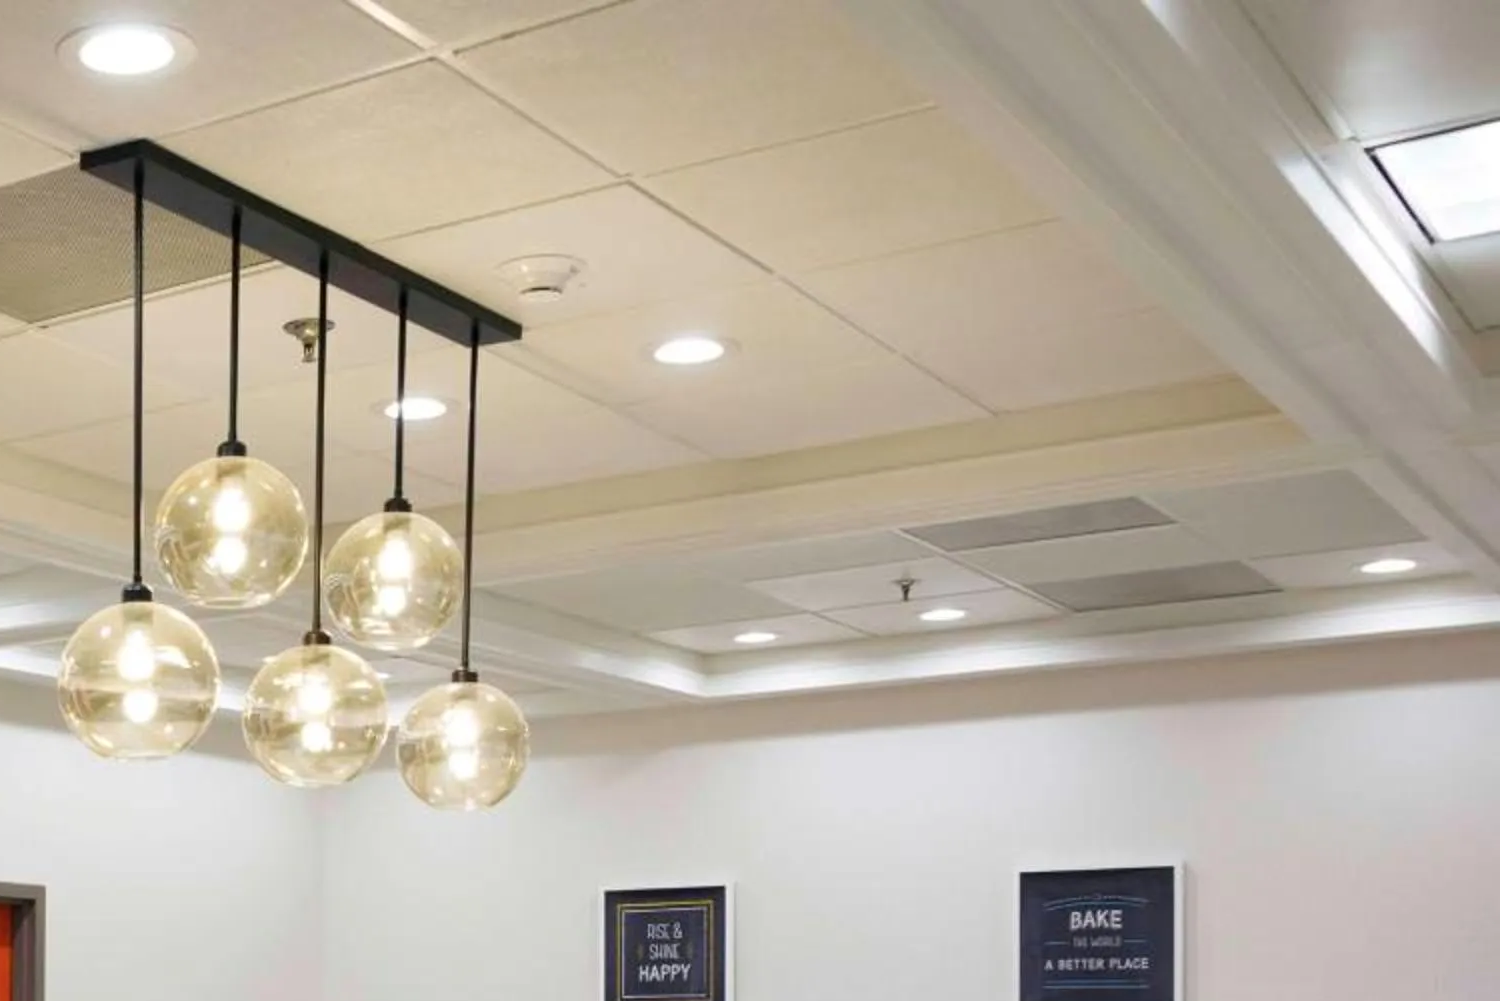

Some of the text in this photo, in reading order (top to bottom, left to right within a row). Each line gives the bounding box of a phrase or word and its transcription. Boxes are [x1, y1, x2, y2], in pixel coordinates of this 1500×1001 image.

[1070, 909, 1123, 931] BAKE
[646, 921, 683, 940] RISE &
[648, 942, 680, 961] SHINE
[638, 963, 691, 983] HAPPY
[1044, 957, 1149, 971] A BETTER PLACE
